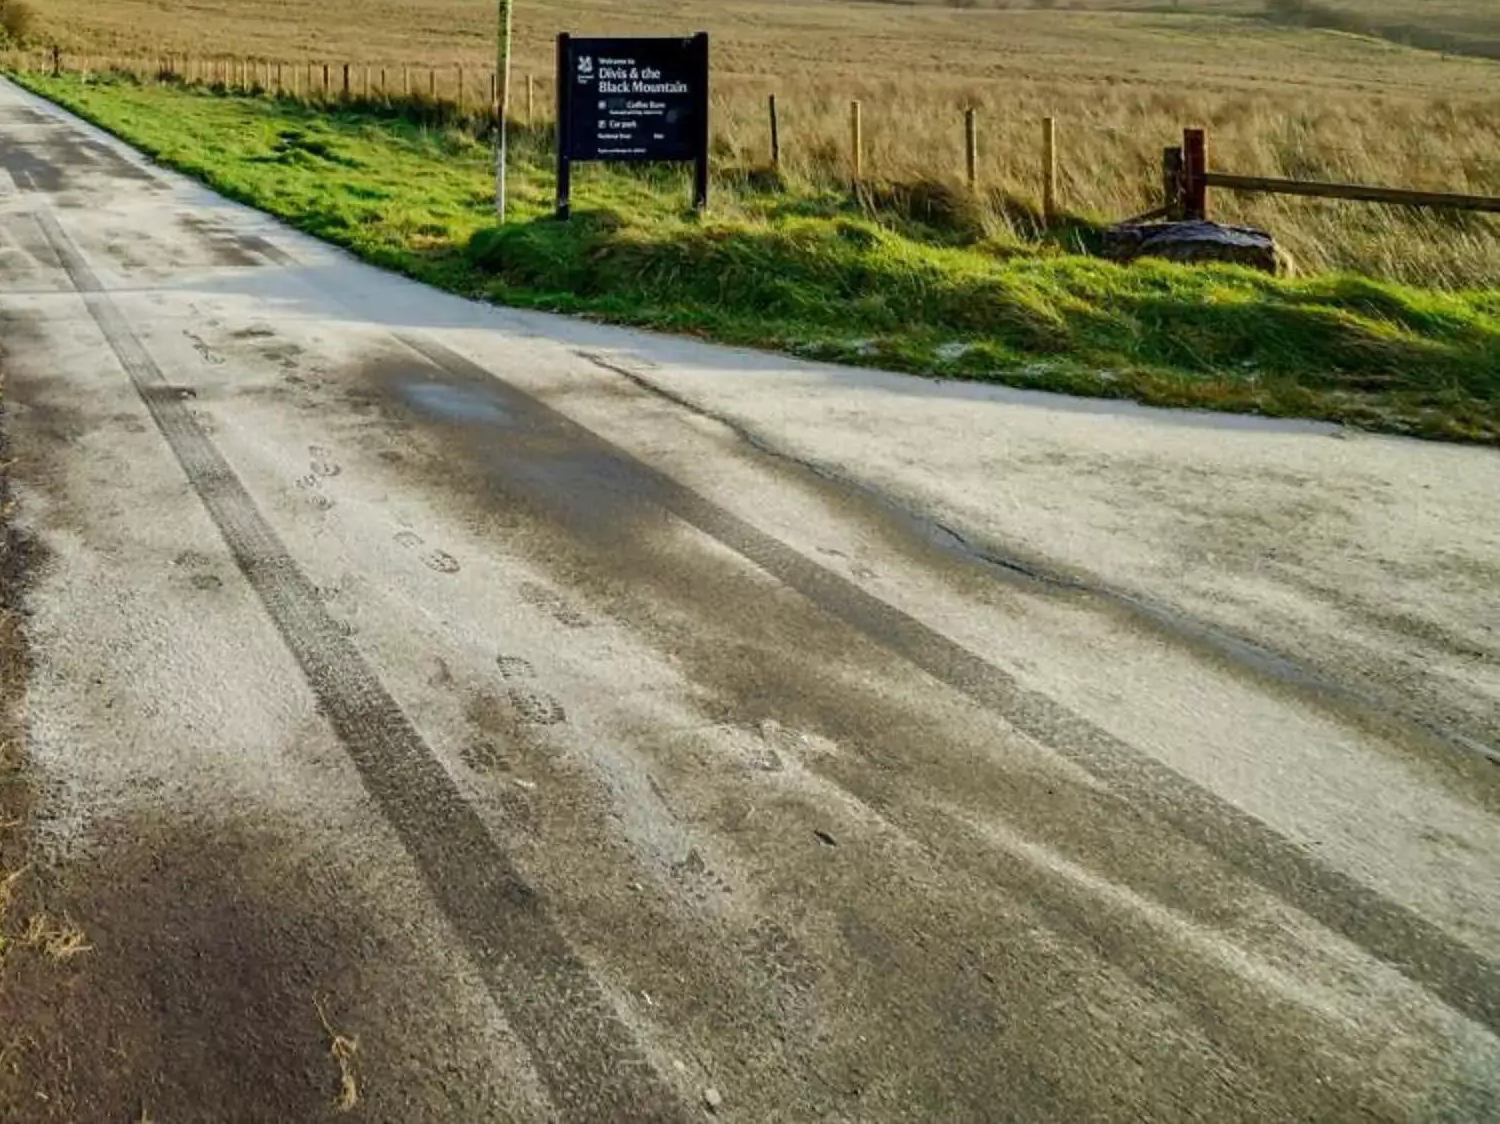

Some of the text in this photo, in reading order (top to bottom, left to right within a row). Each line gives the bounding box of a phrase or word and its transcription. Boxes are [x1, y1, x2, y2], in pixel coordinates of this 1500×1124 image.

[599, 67, 661, 79] Divis & the
[598, 80, 688, 93] Black Mountain
